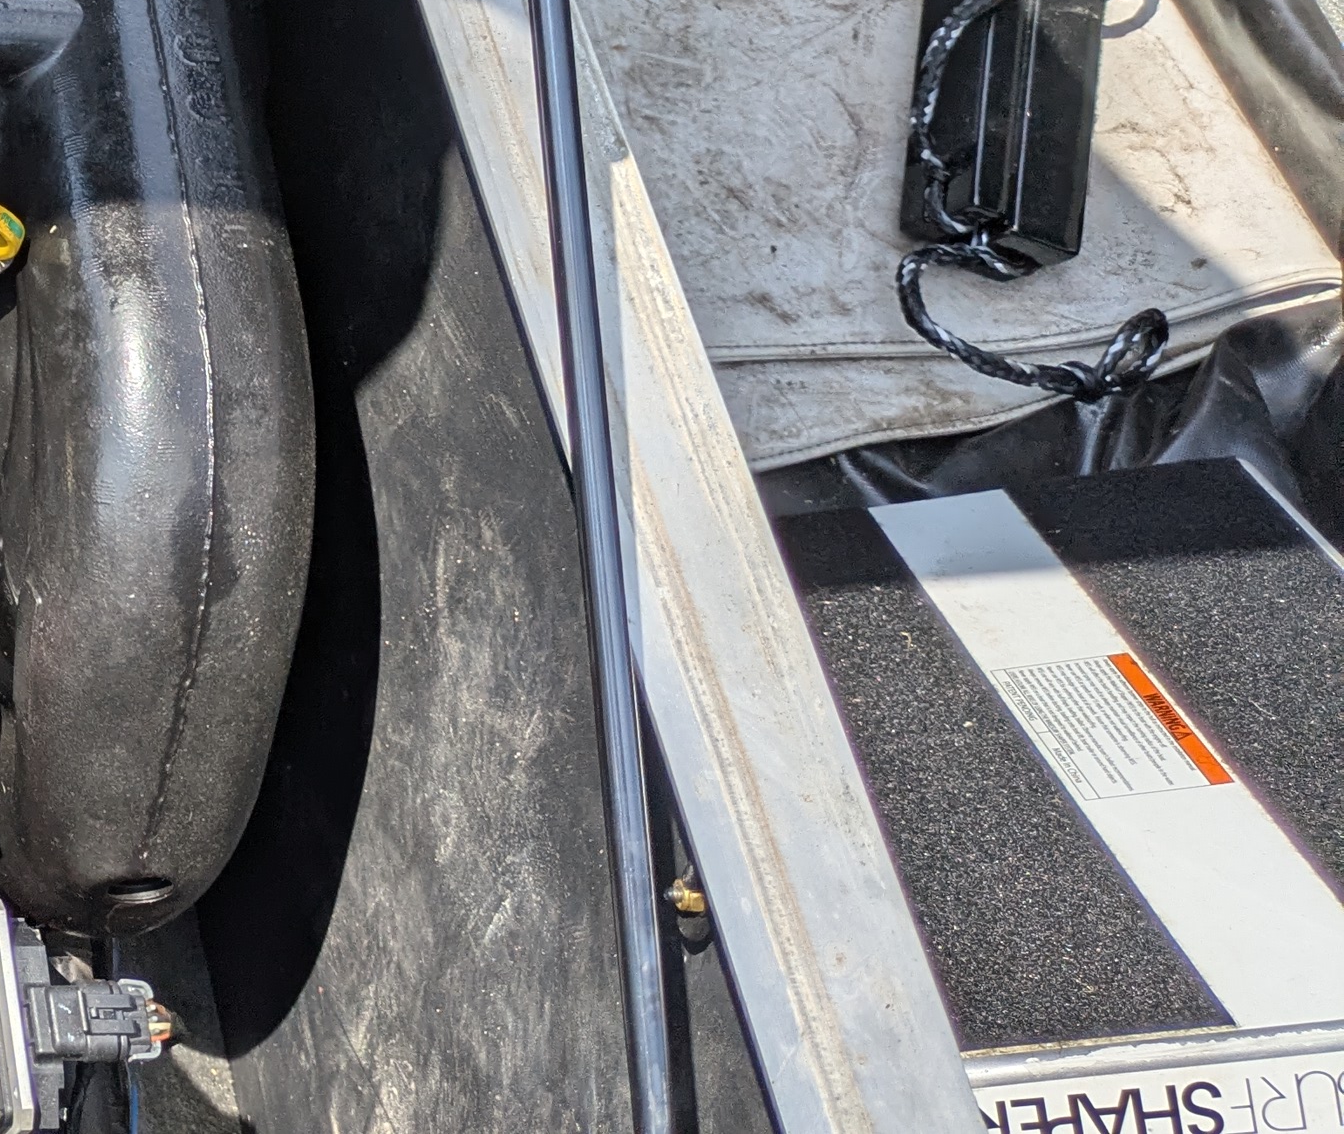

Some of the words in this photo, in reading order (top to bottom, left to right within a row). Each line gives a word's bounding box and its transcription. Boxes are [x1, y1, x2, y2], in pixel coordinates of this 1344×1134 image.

[1001, 681, 1021, 699] PATENT
[1014, 699, 1037, 720] PENDING
[1142, 693, 1185, 729] WARNING
[1051, 747, 1069, 762] Made
[1066, 768, 1084, 782] China
[979, 1081, 1224, 1134] SHAPER
[1230, 1071, 1344, 1134] URF
